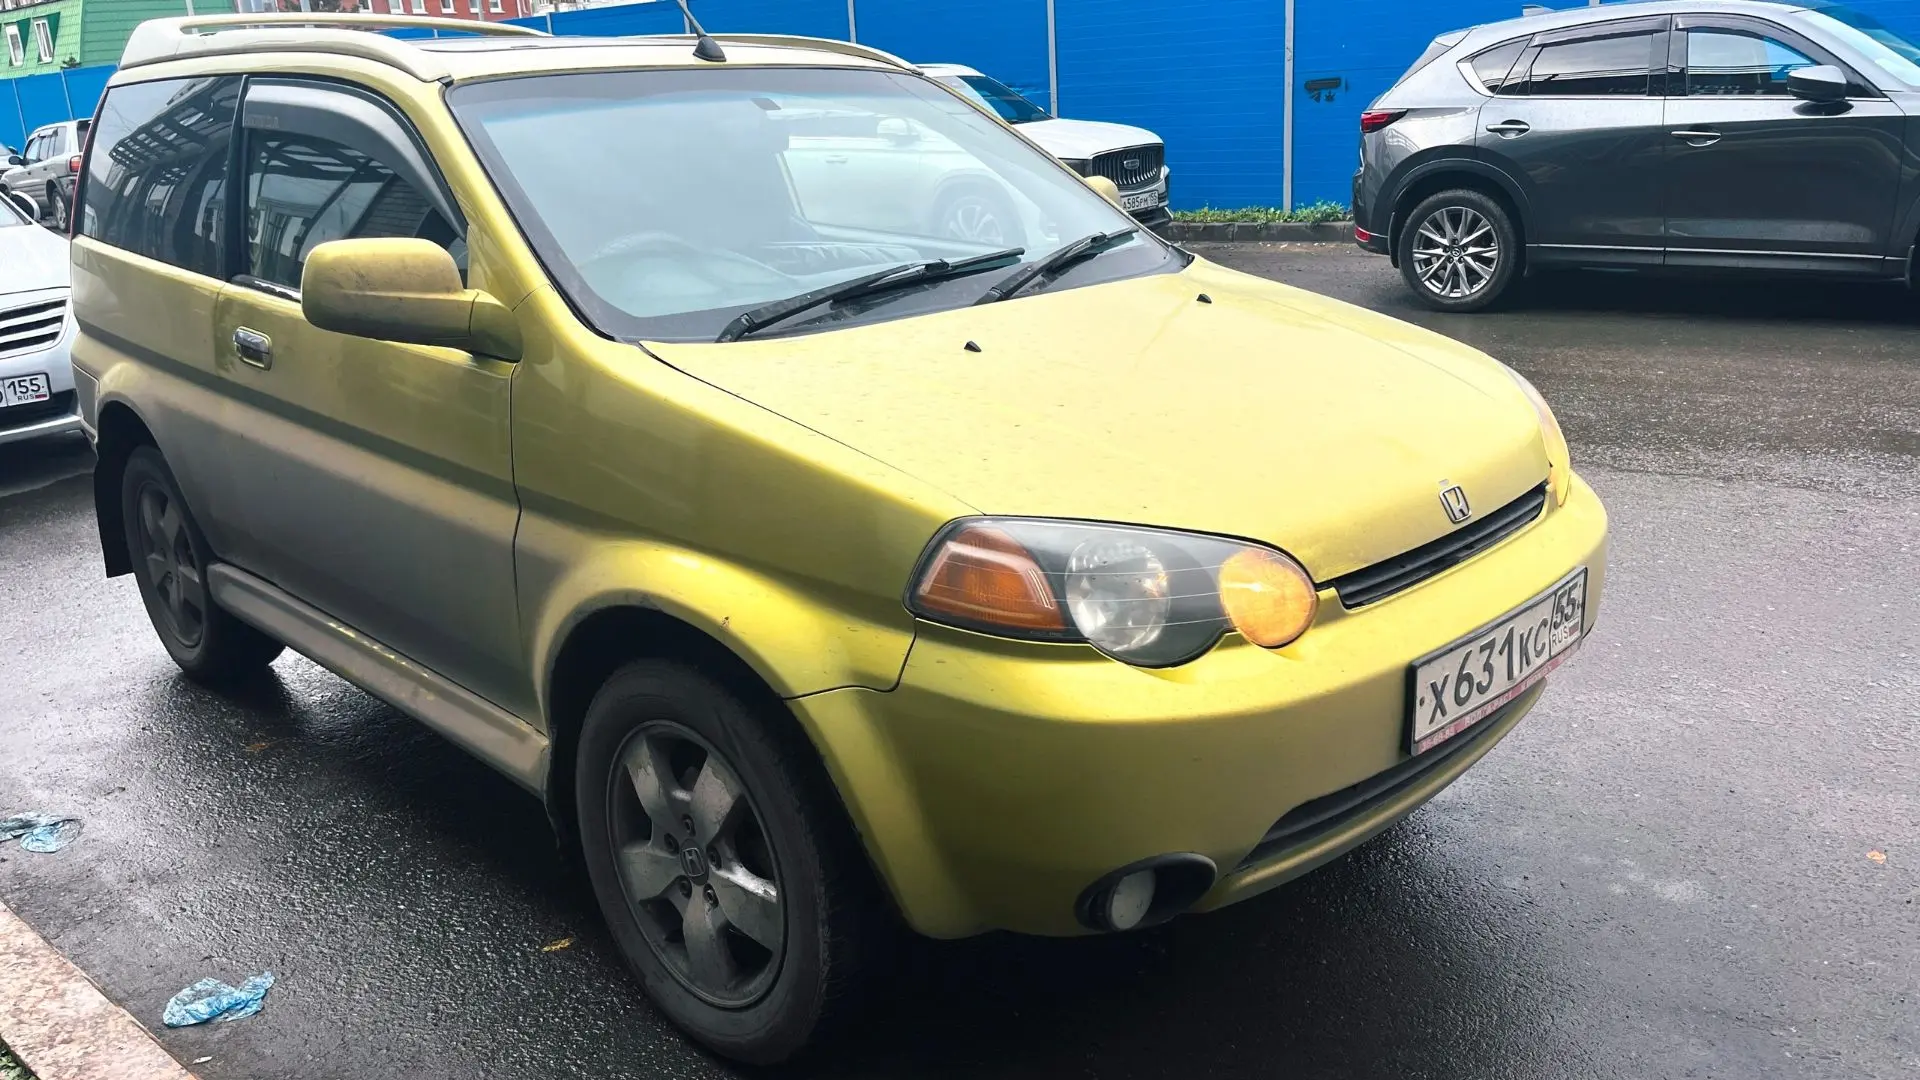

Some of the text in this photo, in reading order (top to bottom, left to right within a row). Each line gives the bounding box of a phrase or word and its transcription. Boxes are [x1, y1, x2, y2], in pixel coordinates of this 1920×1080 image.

[7, 377, 40, 396] 155
[1553, 582, 1579, 630] 55
[1552, 625, 1570, 646] RUS
